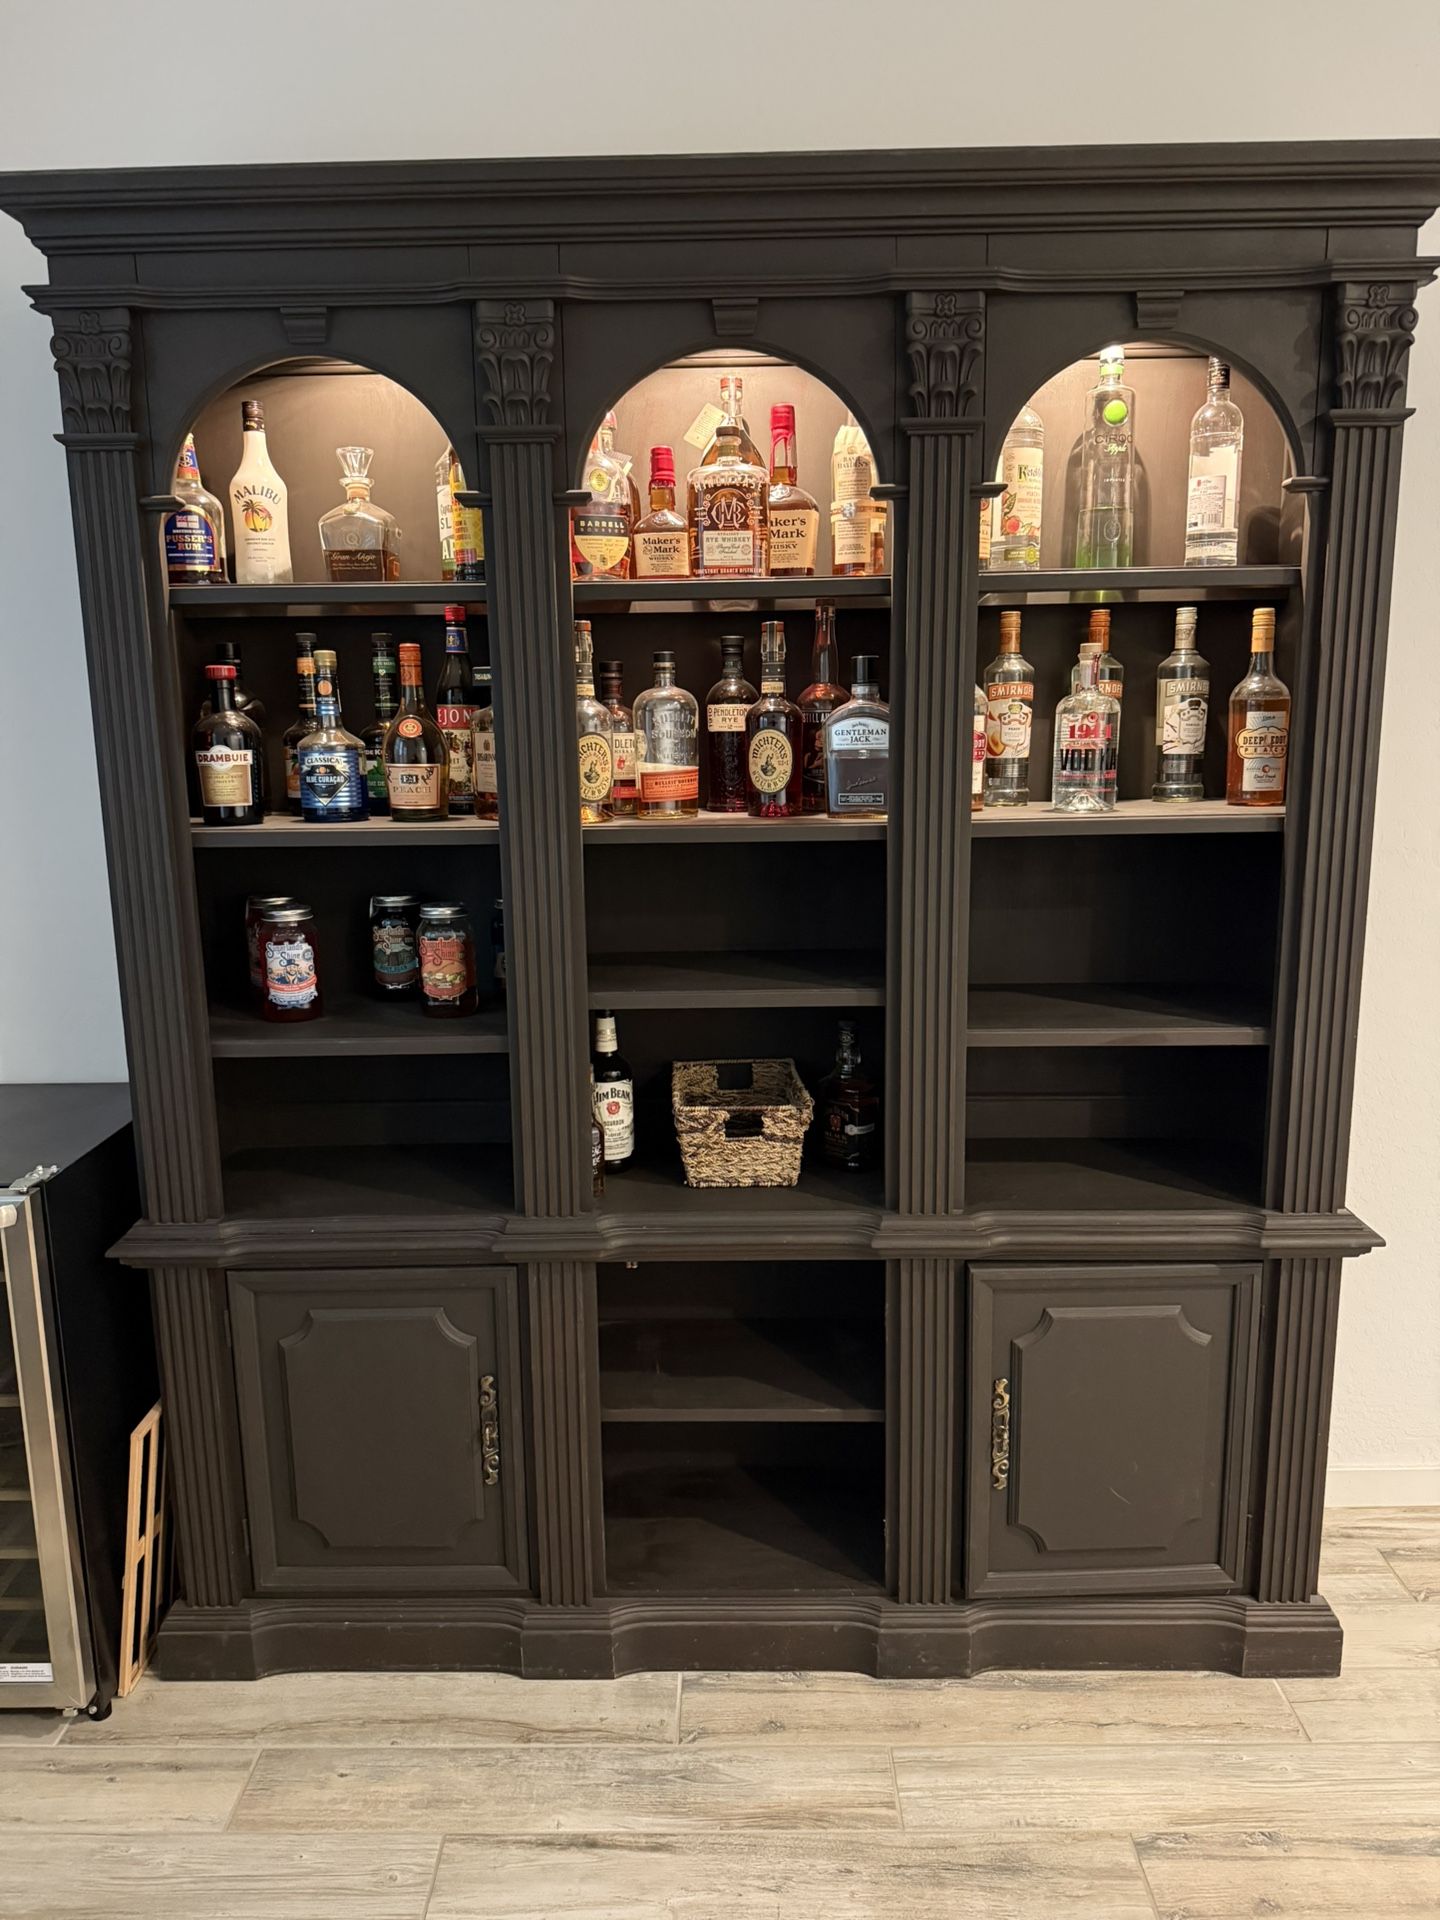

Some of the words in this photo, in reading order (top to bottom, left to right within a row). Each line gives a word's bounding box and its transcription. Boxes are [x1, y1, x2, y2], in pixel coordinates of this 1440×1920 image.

[234, 485, 281, 504] MALIBU
[579, 520, 625, 528] BARRELL
[770, 528, 807, 538] Mark
[166, 534, 213, 543] PUSSER'S
[642, 537, 681, 545] Maker's
[177, 542, 202, 551] RUM
[330, 551, 351, 561] Gran
[713, 708, 747, 717] PENDLETON
[834, 728, 887, 737] GENTLEMAN
[850, 736, 871, 744] JACK
[1243, 736, 1264, 745] DEEP
[752, 736, 788, 760] MICHTER'S
[197, 753, 249, 763] DRAMBUIE
[319, 775, 346, 786] CURAÇAO
[752, 769, 789, 789] BOURBON
[392, 786, 432, 794] PEACH
[595, 1091, 609, 1103] JIM
[610, 1087, 631, 1100] BEAM
